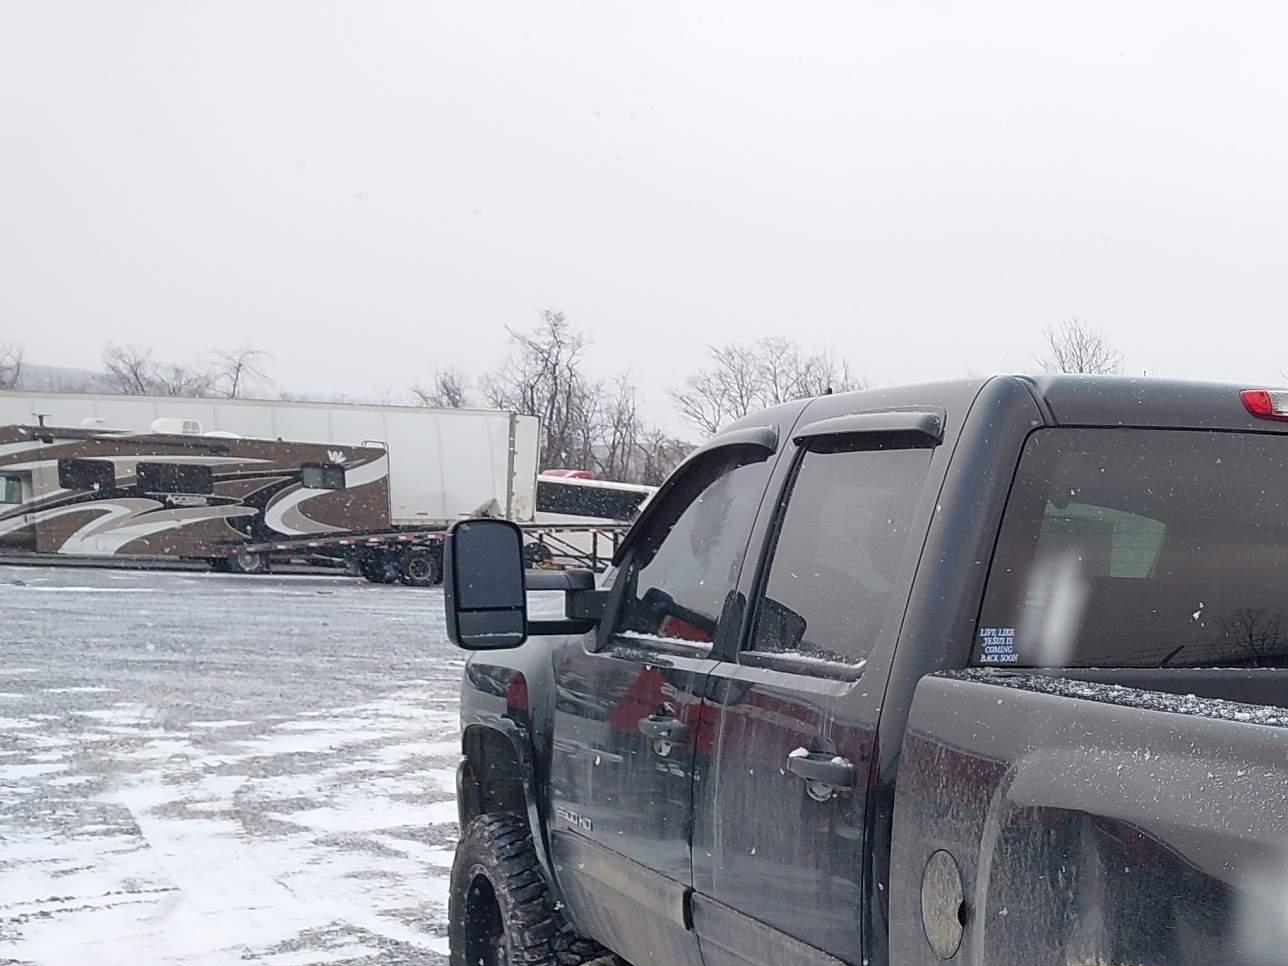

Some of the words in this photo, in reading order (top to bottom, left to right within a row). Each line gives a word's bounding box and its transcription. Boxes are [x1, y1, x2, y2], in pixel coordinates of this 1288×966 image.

[998, 628, 1016, 637] LIKE
[982, 637, 1006, 647] JESUS
[1005, 637, 1014, 645] IS
[984, 646, 1014, 654] COMING
[980, 654, 1000, 663] BACK
[999, 653, 1019, 663] SOON
